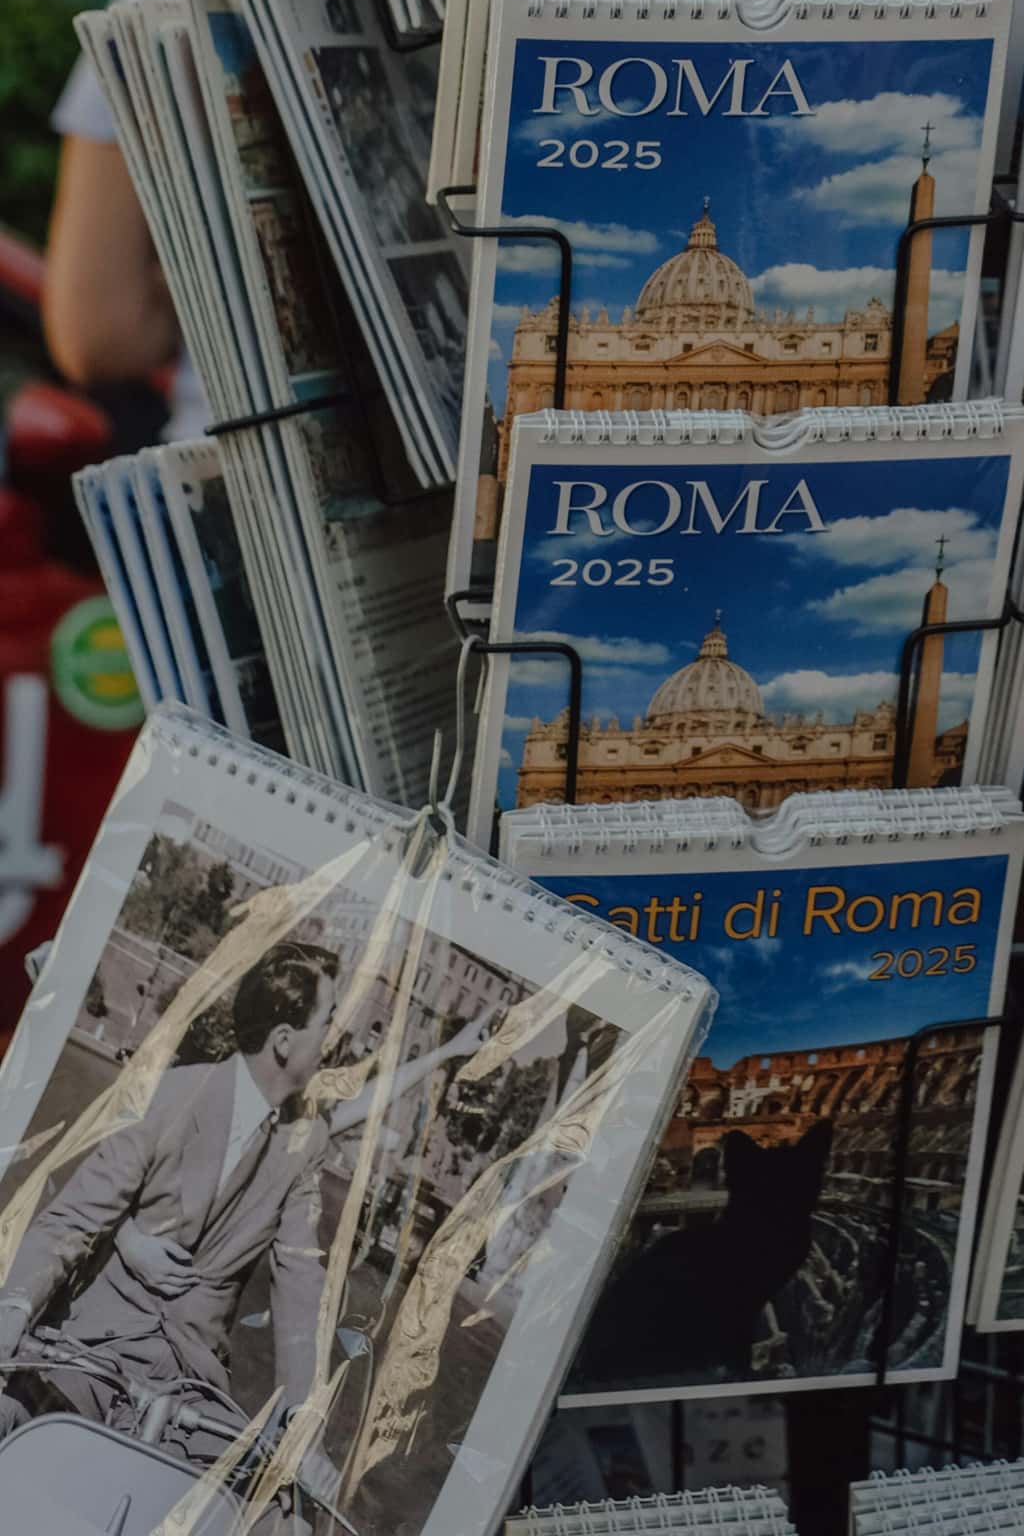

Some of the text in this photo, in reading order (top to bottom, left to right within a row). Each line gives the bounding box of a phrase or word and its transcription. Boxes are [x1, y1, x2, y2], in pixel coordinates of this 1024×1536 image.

[532, 56, 816, 118] ROMA
[537, 139, 662, 172] 2025
[546, 479, 831, 536] ROMA
[549, 558, 674, 587] 2025
[724, 888, 782, 941] di
[802, 885, 982, 936] Roma
[868, 944, 977, 981] 2025
